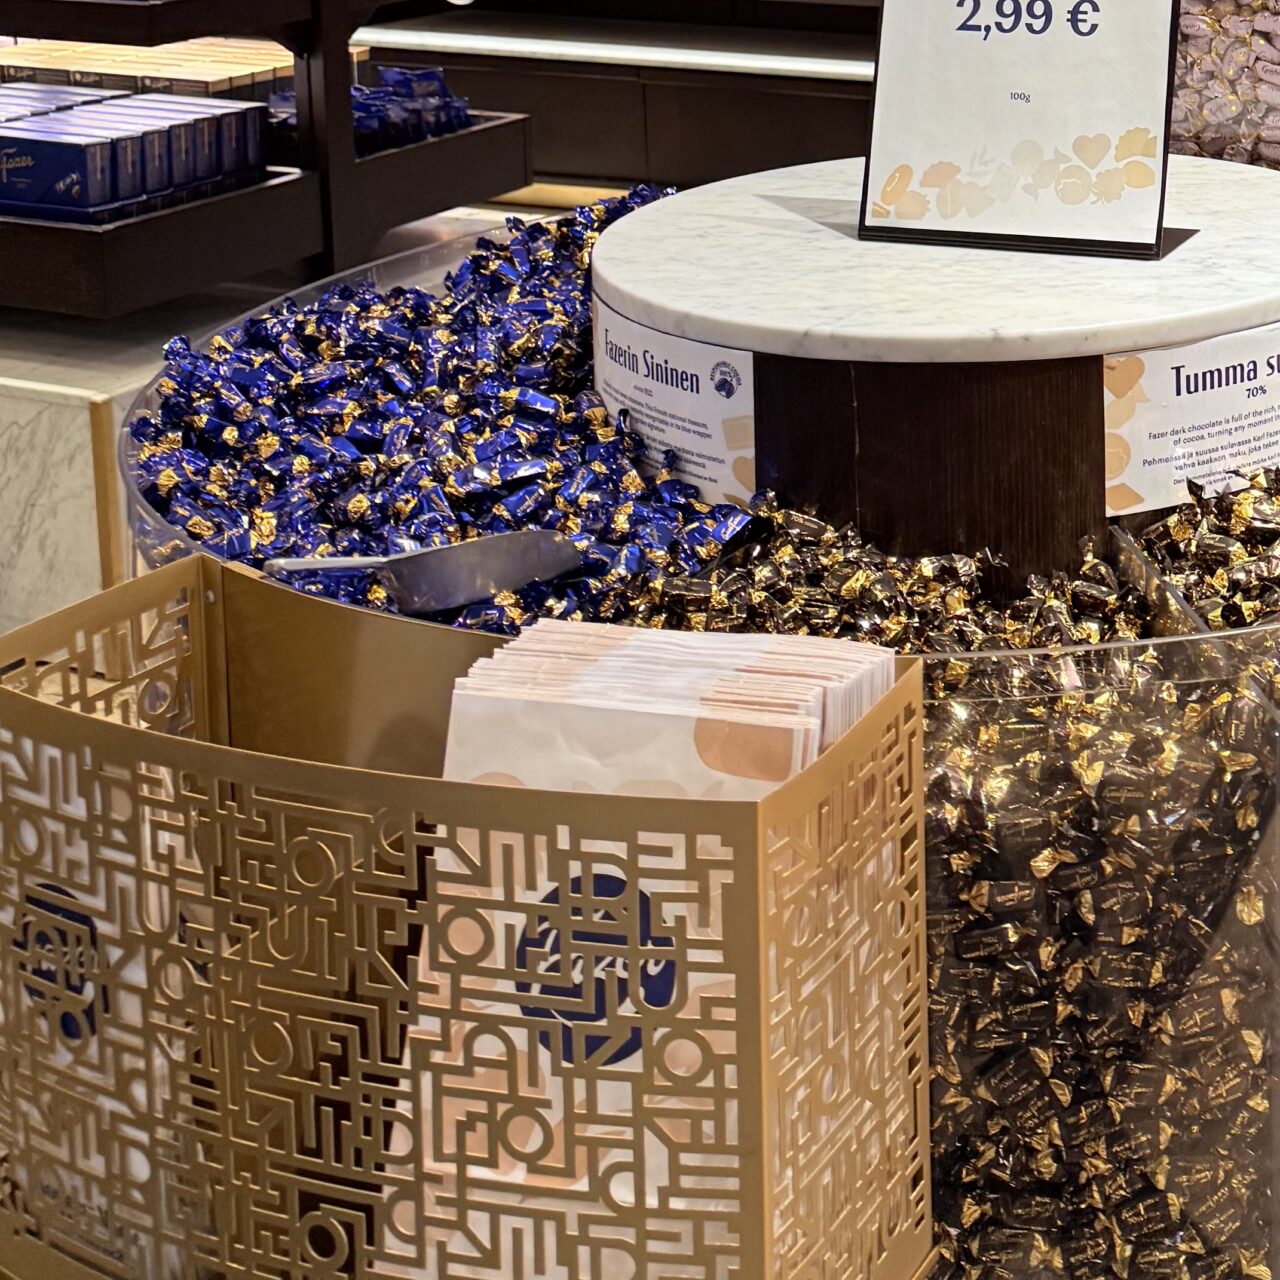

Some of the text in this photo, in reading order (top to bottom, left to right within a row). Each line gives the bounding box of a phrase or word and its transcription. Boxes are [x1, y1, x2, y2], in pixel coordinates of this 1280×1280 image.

[1009, 90, 1031, 105] 100g
[605, 328, 639, 375] Fazerin
[643, 349, 700, 395] Sininen
[1171, 359, 1258, 397] Tumma
[1246, 385, 1267, 399] 70%
[1149, 431, 1168, 440] Fazer
[1170, 427, 1187, 436] dark
[1187, 420, 1223, 433] chocolate
[1224, 417, 1230, 425] is
[1231, 413, 1243, 423] full
[1244, 412, 1251, 420] of
[1252, 409, 1263, 418] the
[1173, 437, 1181, 446] of
[1207, 428, 1233, 439] turning
[1234, 424, 1245, 433] any
[1247, 417, 1274, 429] moment
[1195, 446, 1219, 457] suussa
[1253, 432, 1266, 442] Karl
[1266, 429, 1280, 438] Fazer
[1174, 460, 1196, 471] vahva
[1248, 445, 1262, 456] joka
